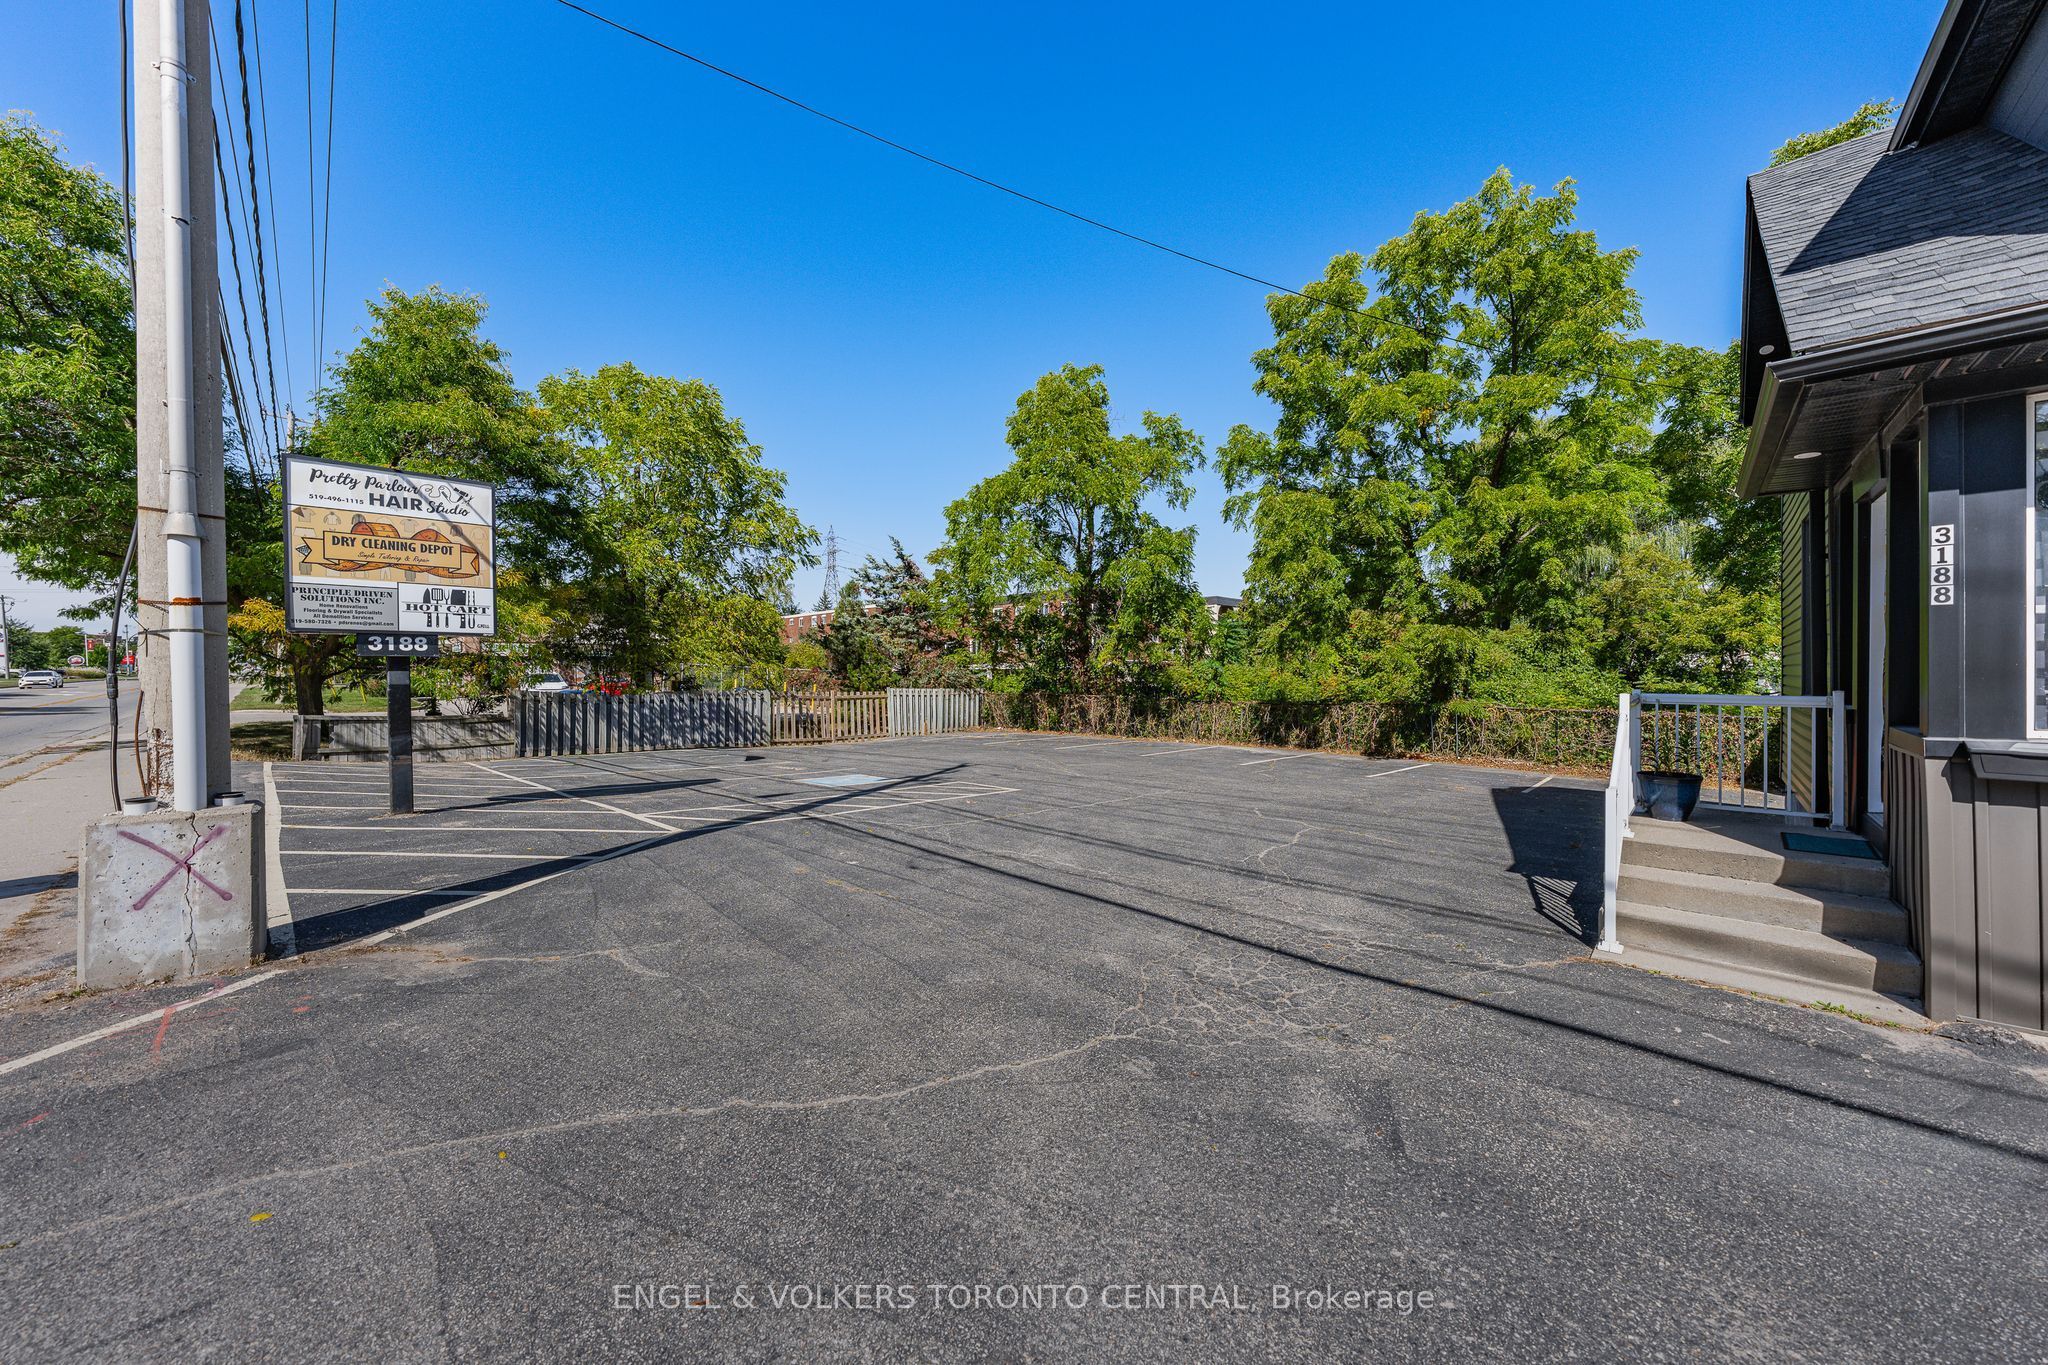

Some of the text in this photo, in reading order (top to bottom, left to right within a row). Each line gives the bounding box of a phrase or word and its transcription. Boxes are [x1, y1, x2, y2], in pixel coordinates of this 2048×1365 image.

[309, 467, 419, 495] Pretty Parlour
[308, 493, 364, 505] 519-496-1115
[369, 492, 470, 517] HAIR Studio
[331, 535, 454, 556] DRY CLEANING DEPOT
[357, 551, 375, 559] Simple
[412, 555, 430, 564] Repair
[1933, 526, 1952, 604] 3188
[292, 586, 393, 598] PRINCIPLE DRIVEN
[300, 594, 385, 605] SOLUTIONS INC.
[405, 603, 490, 615] HOT CART
[367, 636, 429, 652] 3188
